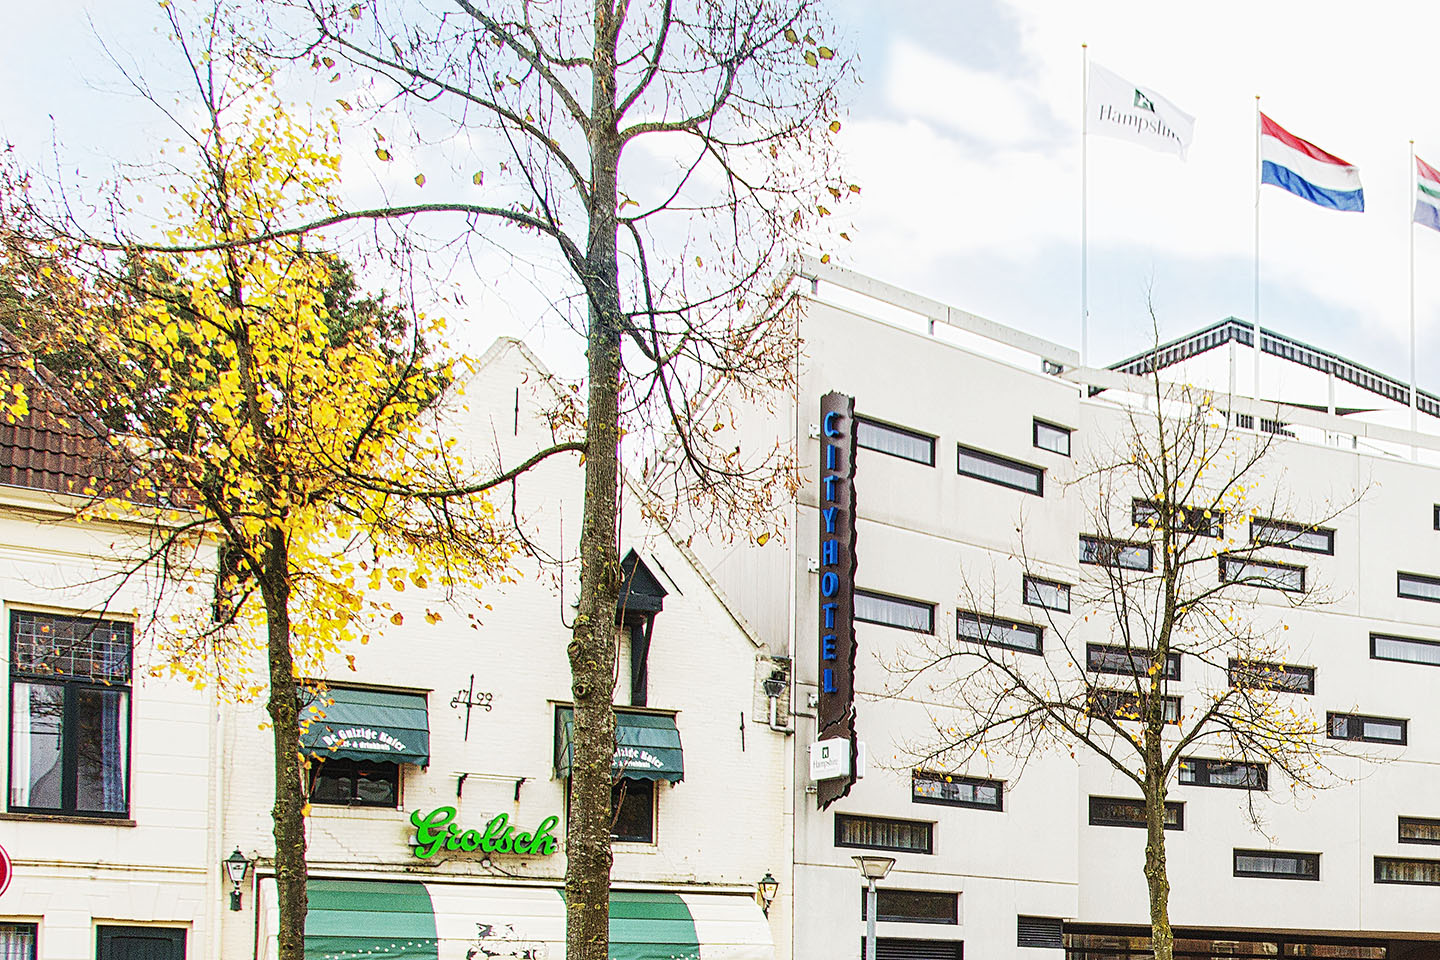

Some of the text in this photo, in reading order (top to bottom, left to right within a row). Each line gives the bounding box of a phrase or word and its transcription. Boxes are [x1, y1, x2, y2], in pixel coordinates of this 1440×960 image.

[822, 412, 839, 693] CITYHOTEL
[322, 728, 406, 751] De Gulzige Kater
[410, 806, 559, 859] Grolsch
